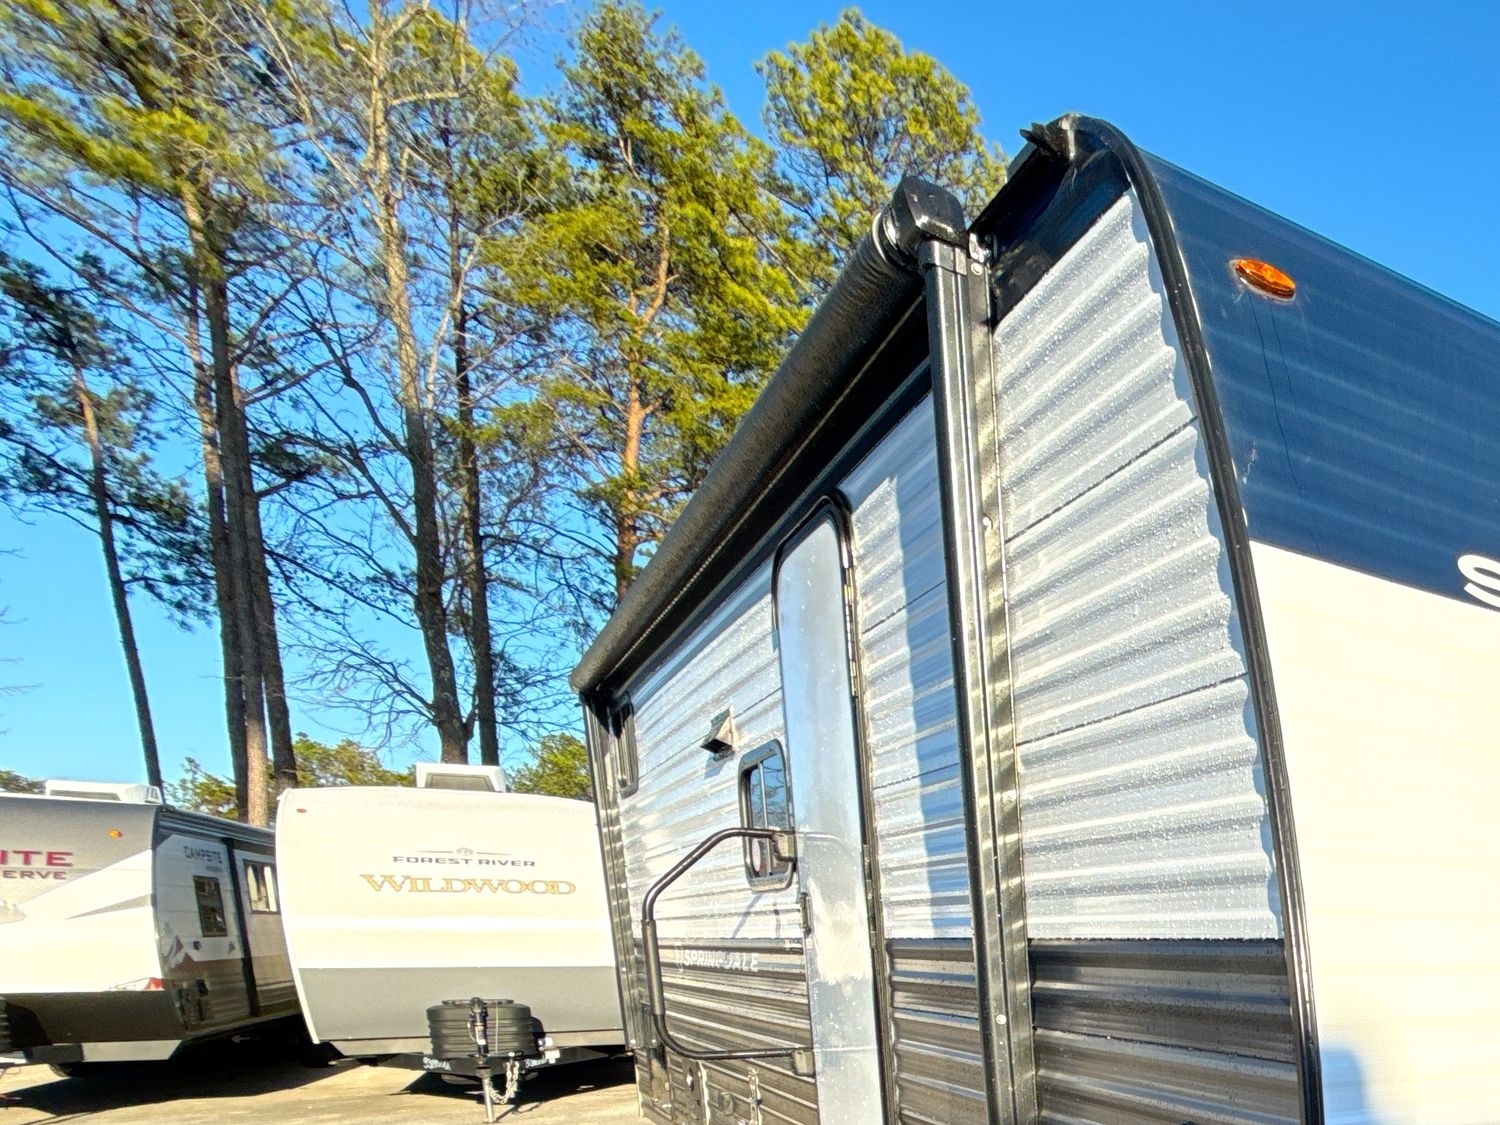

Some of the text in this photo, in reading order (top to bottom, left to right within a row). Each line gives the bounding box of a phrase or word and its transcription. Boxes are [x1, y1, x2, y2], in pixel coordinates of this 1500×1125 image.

[392, 856, 536, 867] FOREST RIVER
[359, 874, 577, 895] WILDWOOD
